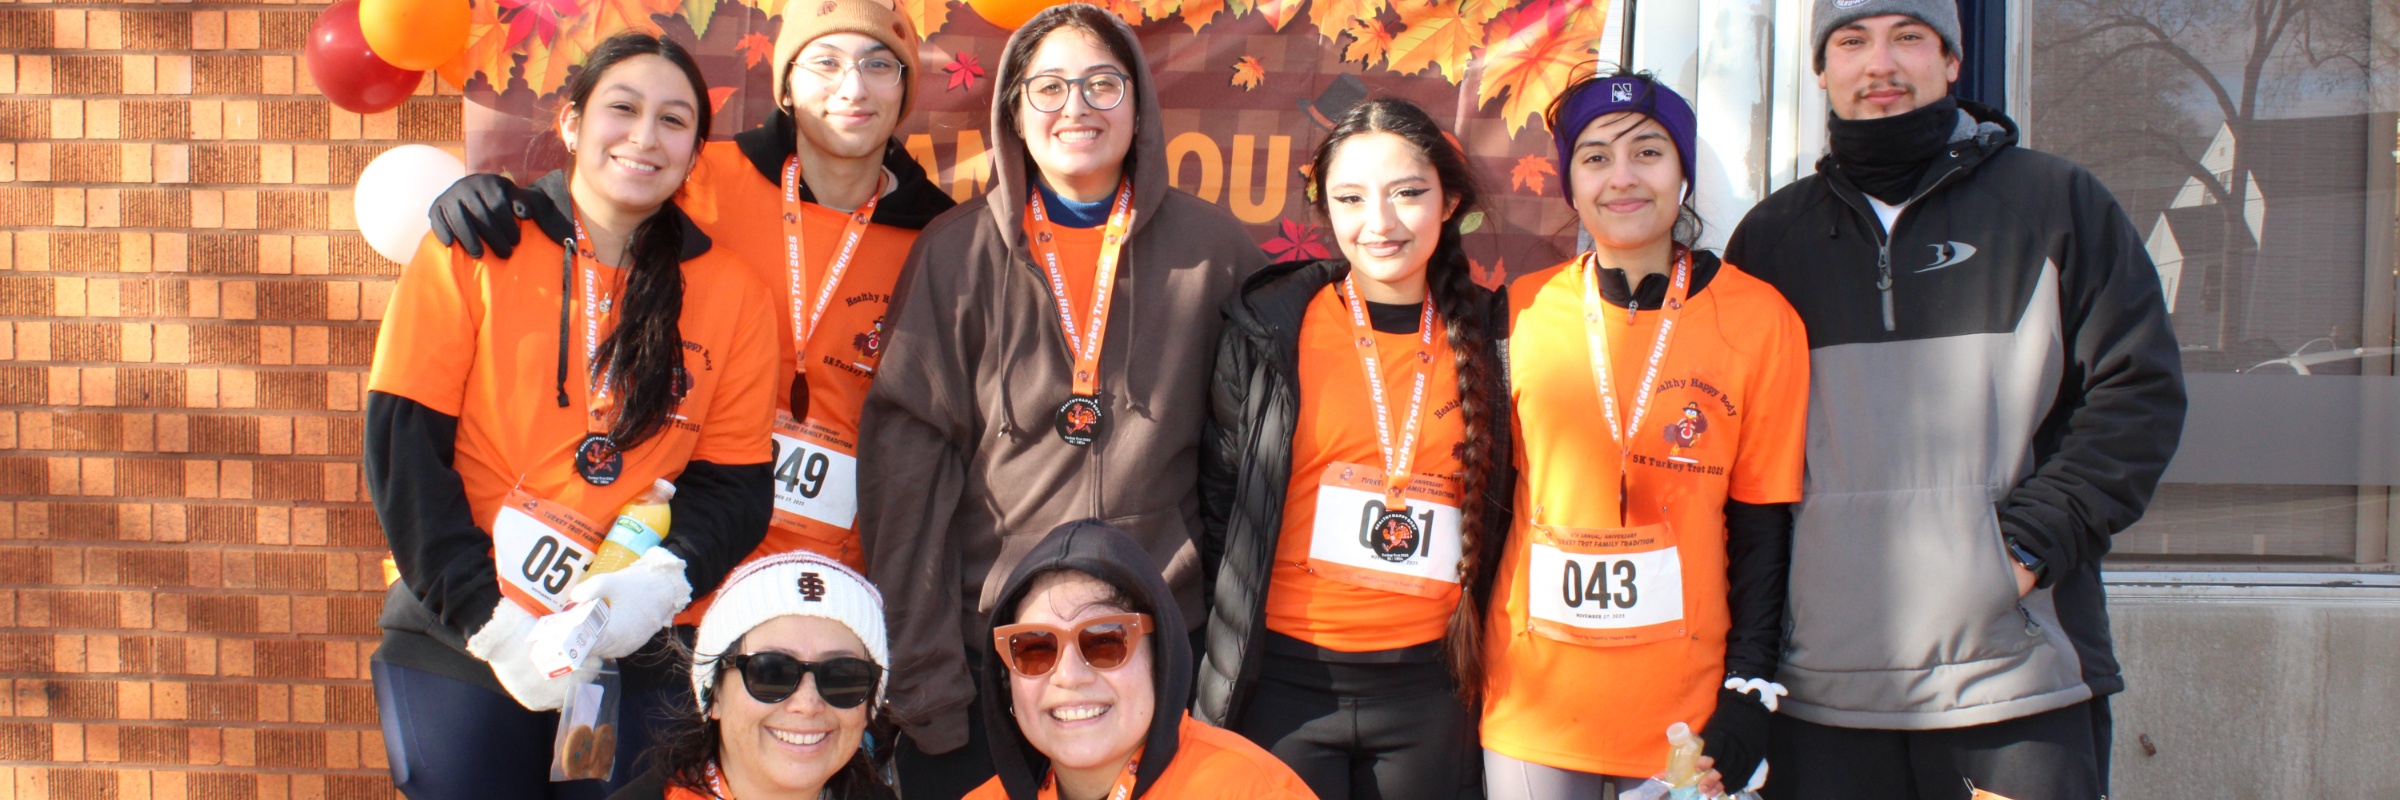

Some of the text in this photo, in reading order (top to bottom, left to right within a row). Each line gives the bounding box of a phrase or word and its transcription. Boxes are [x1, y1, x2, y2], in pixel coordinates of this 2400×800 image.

[1166, 131, 1291, 223] OU
[832, 231, 858, 275] Healthy
[585, 268, 597, 318] Healthy
[789, 235, 803, 341] Turkey Trot 2025
[816, 275, 838, 312] Happy
[1046, 252, 1064, 296] Healthy
[1059, 298, 1075, 334] Happy
[1676, 264, 1686, 289] 2025
[845, 292, 879, 307] Healthy
[1345, 279, 1357, 299] Trot
[1351, 300, 1365, 327] 2025
[586, 318, 597, 359] Happy
[1084, 317, 1102, 360] Turkey
[1093, 289, 1106, 316] Trot
[1422, 305, 1434, 345] Healthy
[682, 339, 703, 353] appy
[1412, 372, 1425, 403] 2025
[1596, 367, 1609, 395] Trot
[1627, 318, 1673, 438] Healthy Happy Body
[1656, 378, 1737, 417] ealthy Happy Body
[1365, 357, 1383, 403] Healthy
[1376, 404, 1390, 445] Happy
[1406, 403, 1419, 431] Trot
[1603, 396, 1619, 441] Turkey
[784, 423, 799, 432] TROT
[800, 427, 823, 439] FAMILY
[823, 434, 853, 449] TRADITION
[1395, 432, 1414, 477] Turkey
[1633, 455, 1724, 475] 5K Turkey Trot 2025
[1407, 485, 1426, 494] AMILY
[544, 511, 567, 527] TURKEY
[568, 523, 583, 535] TROT
[1359, 499, 1434, 558] 01
[1620, 538, 1655, 546] TRADITION
[522, 534, 593, 595] 05
[1562, 559, 1638, 609] 043
